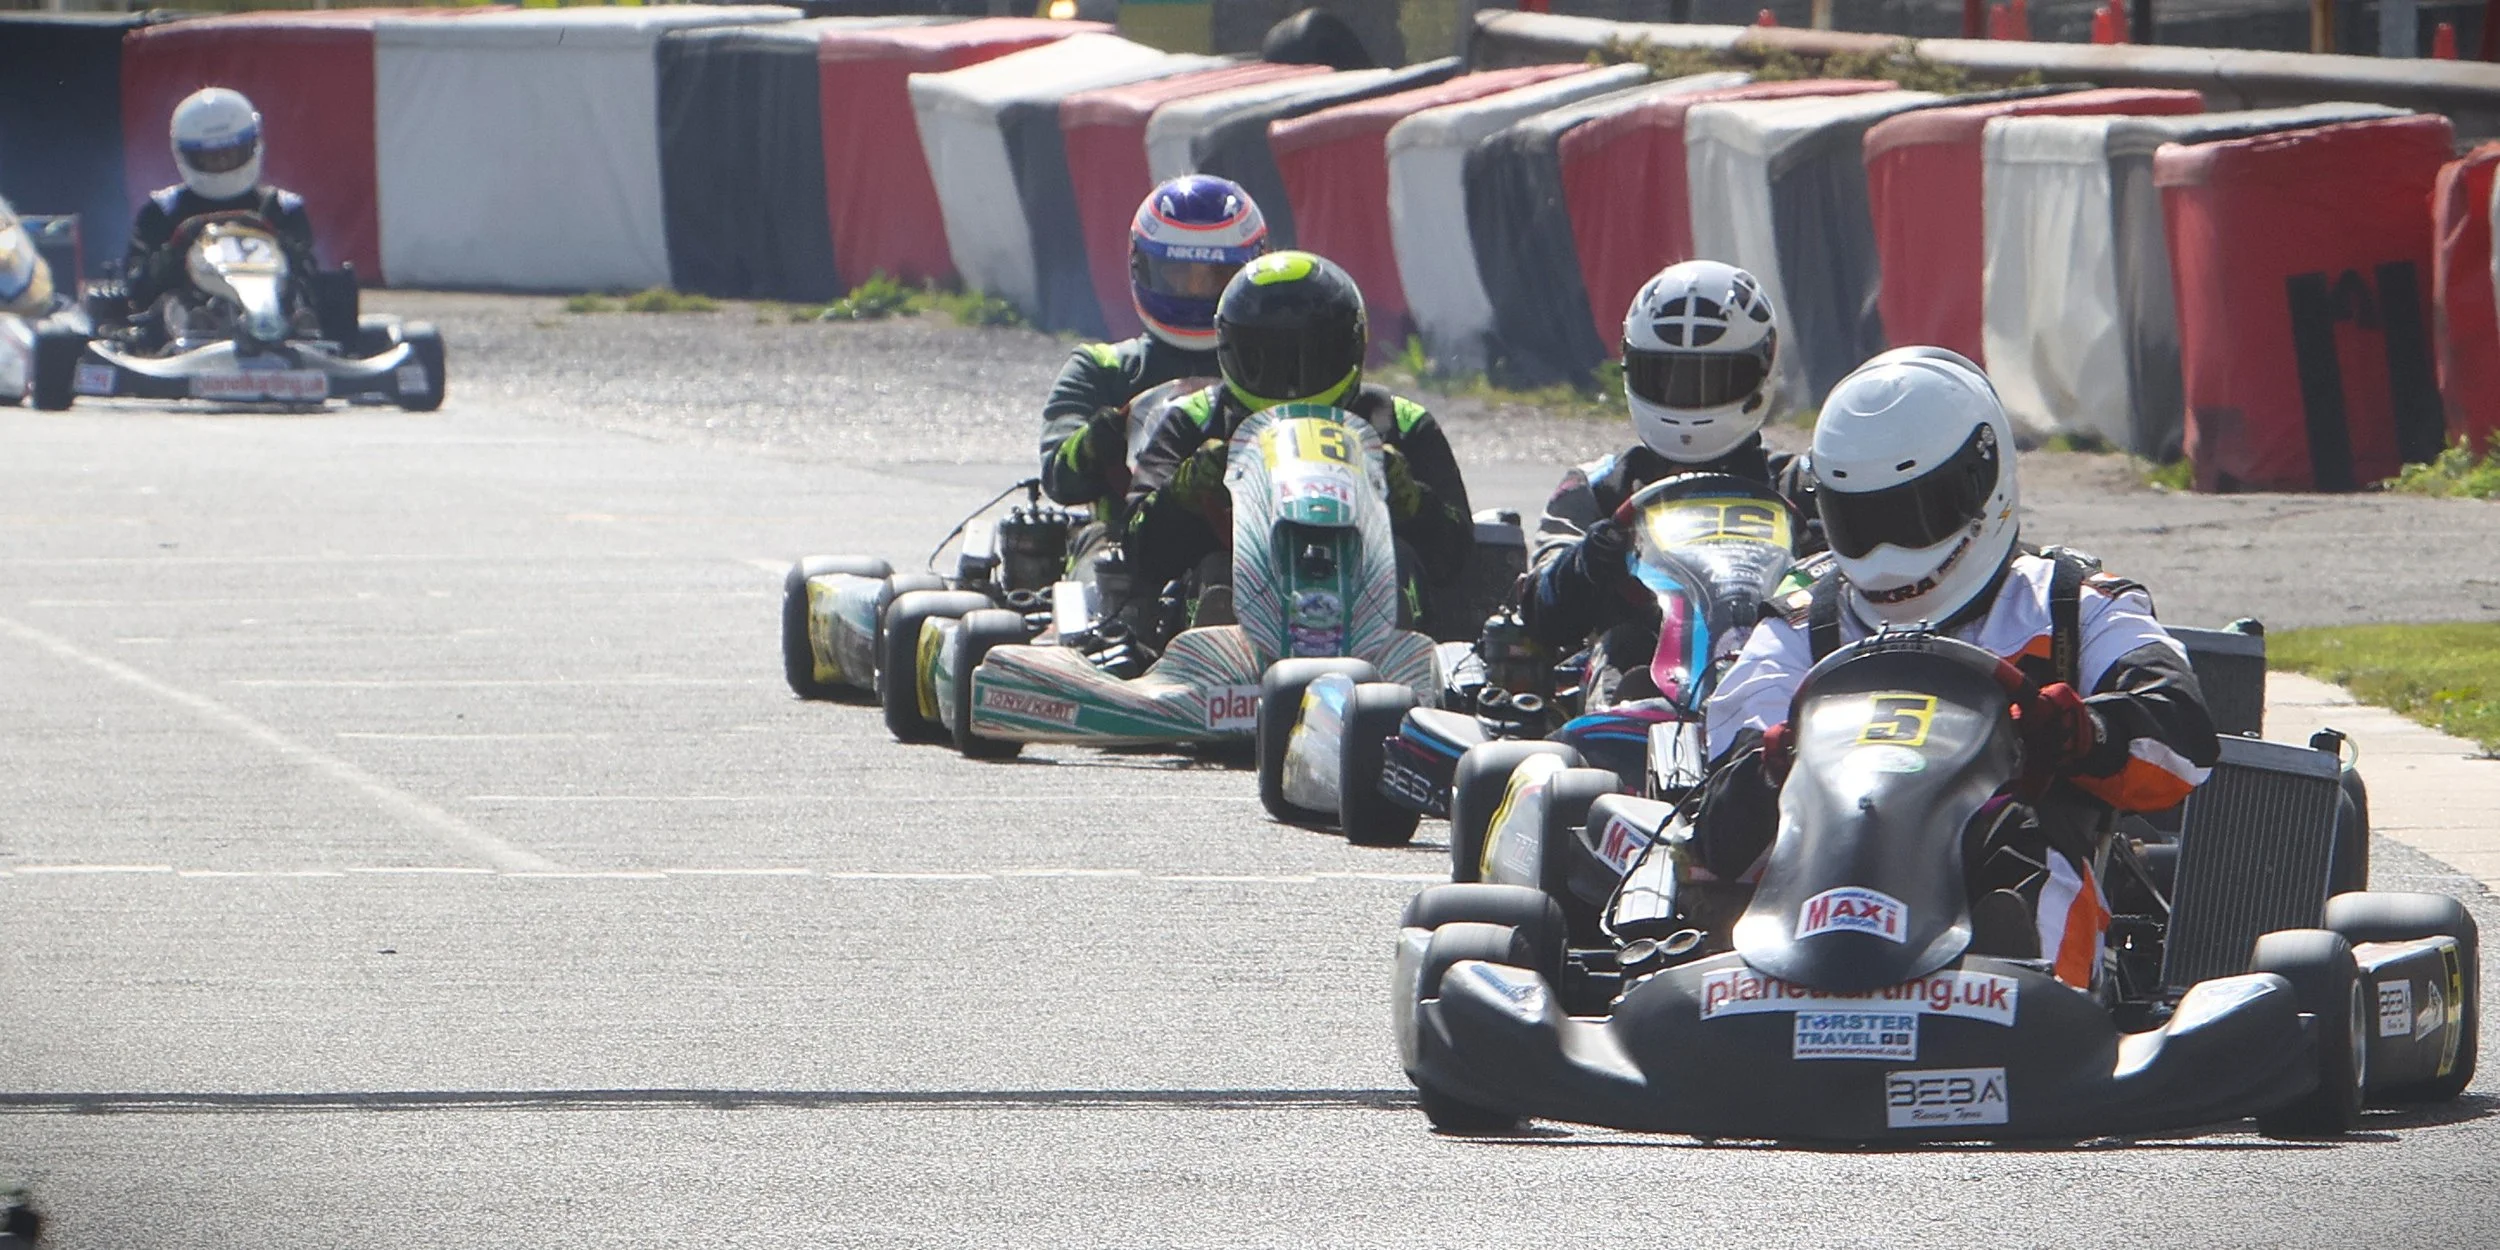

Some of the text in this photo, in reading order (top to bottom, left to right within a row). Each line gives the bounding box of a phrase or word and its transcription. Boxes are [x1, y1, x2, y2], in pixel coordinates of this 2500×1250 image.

[1166, 245, 1225, 262] NKRA
[1866, 698, 1928, 740] 5
[1797, 1033, 1876, 1045] TRAVEL
[1888, 1076, 2004, 1106] BEBA
